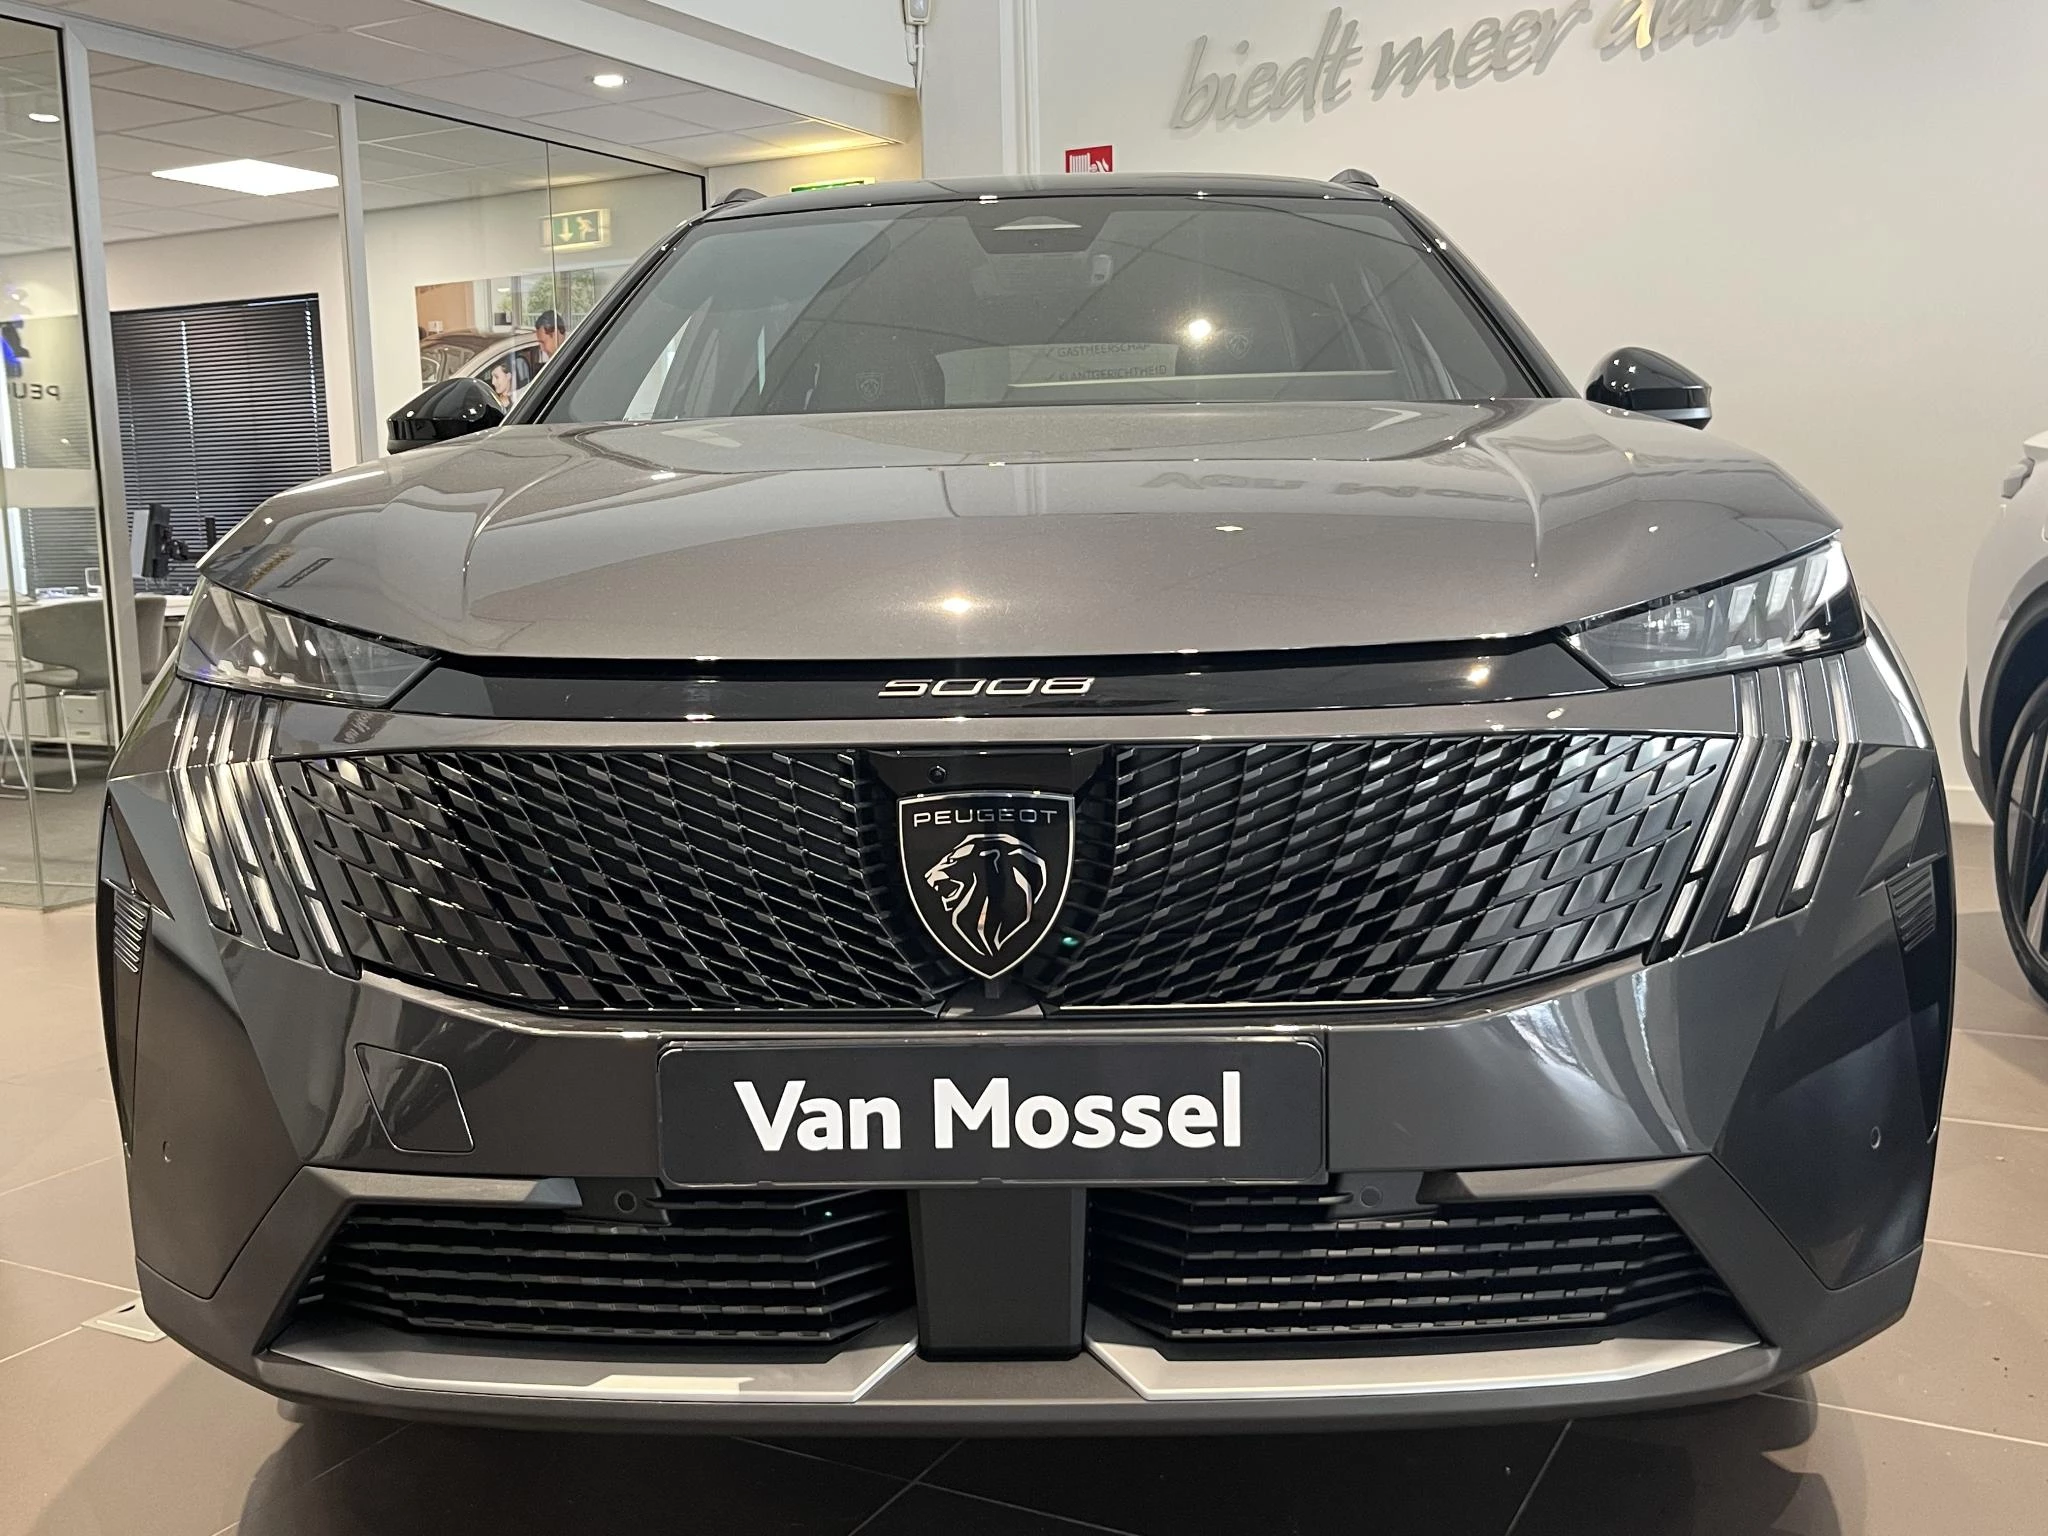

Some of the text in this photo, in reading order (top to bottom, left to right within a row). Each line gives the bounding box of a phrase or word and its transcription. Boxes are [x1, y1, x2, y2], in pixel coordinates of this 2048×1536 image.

[1169, 6, 1363, 130] biedt
[1371, 0, 1590, 93] meer
[878, 677, 1095, 697] 5008
[913, 808, 1058, 828] PEUGEOT
[734, 1071, 1241, 1151] Van Mossel
